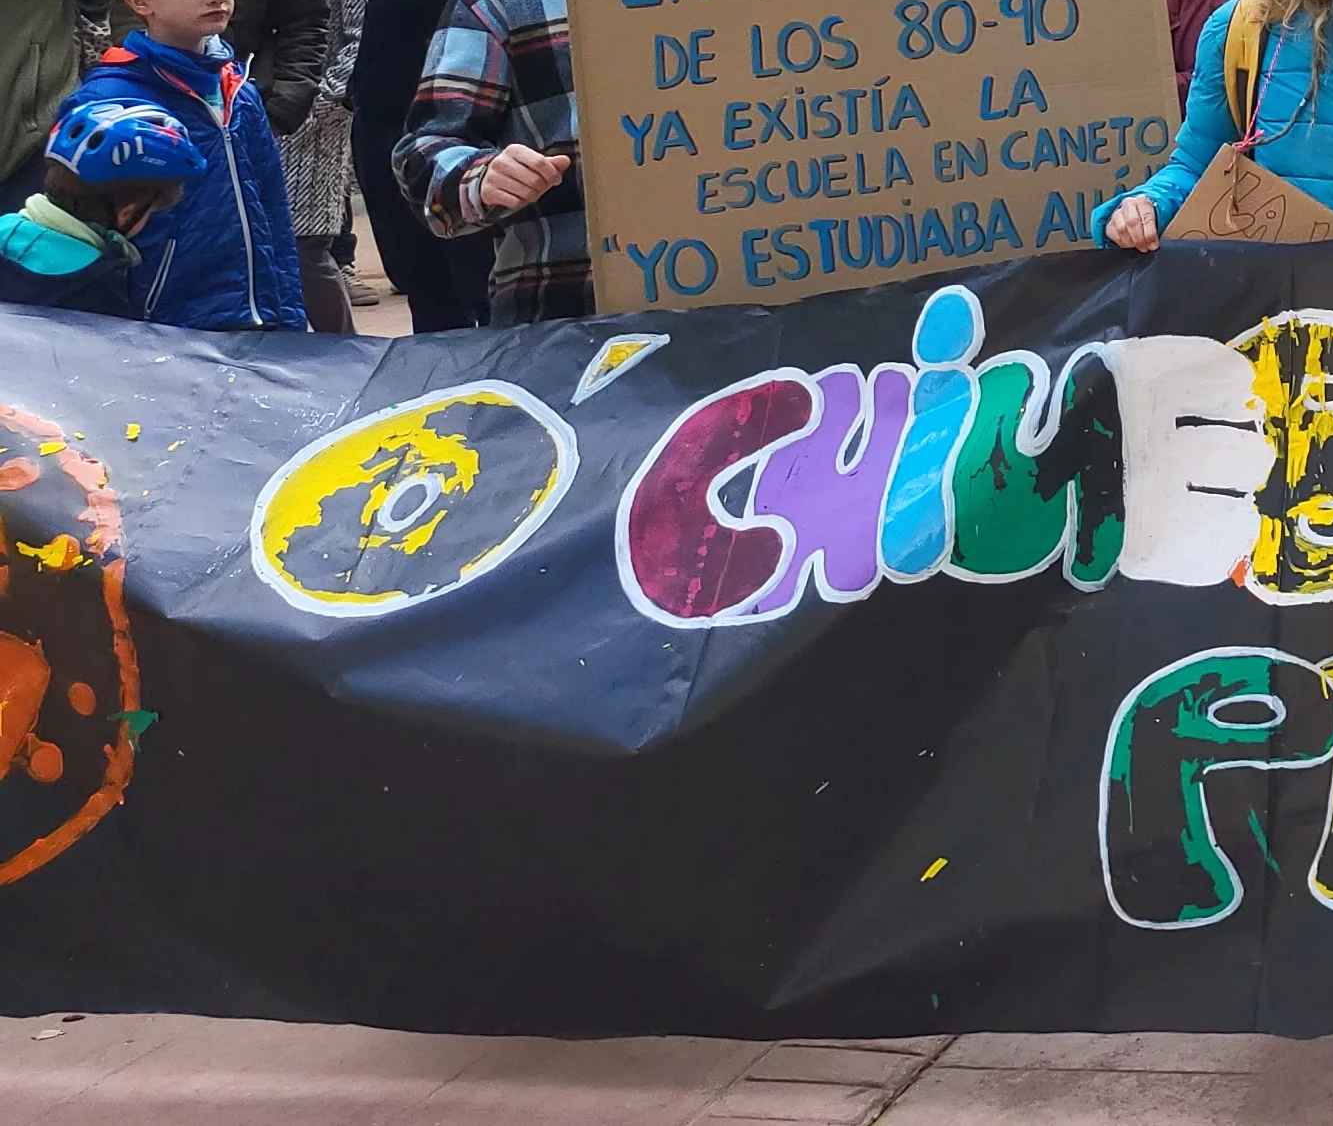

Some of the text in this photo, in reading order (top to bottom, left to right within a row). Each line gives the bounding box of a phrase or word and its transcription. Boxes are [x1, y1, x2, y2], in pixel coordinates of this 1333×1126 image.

[654, 29, 718, 90] DE
[751, 15, 859, 78] LOS
[621, 110, 697, 166] YA
[980, 68, 1048, 121] LA
[697, 116, 1170, 214] ESCUELA EN CANETO
